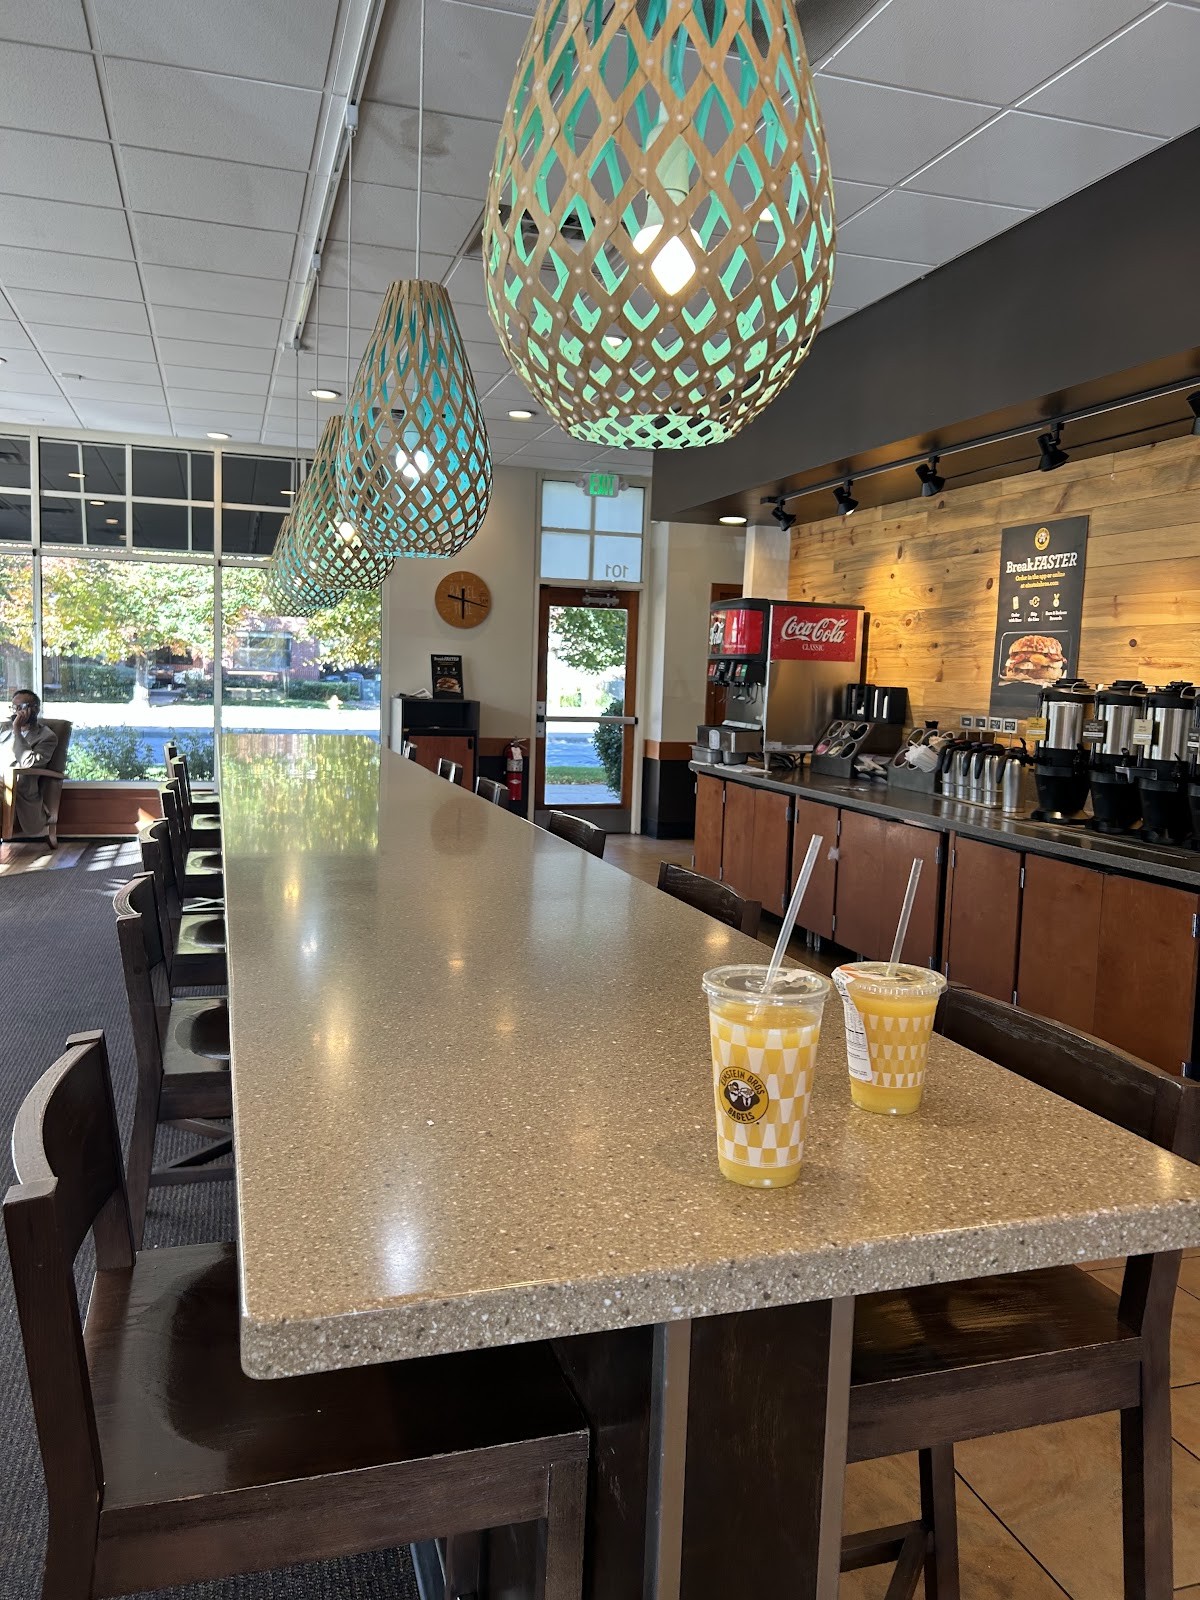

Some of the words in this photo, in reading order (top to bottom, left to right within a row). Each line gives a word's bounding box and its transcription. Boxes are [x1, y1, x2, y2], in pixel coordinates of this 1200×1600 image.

[590, 474, 614, 496] EXIT
[1006, 552, 1078, 573] BreakFASTER
[781, 616, 848, 643] Coca-Cola
[802, 643, 825, 652] CLASSIC
[721, 1069, 745, 1086] EINSTEIN
[747, 1075, 765, 1095] BROS
[727, 1107, 755, 1121] BAGELS
